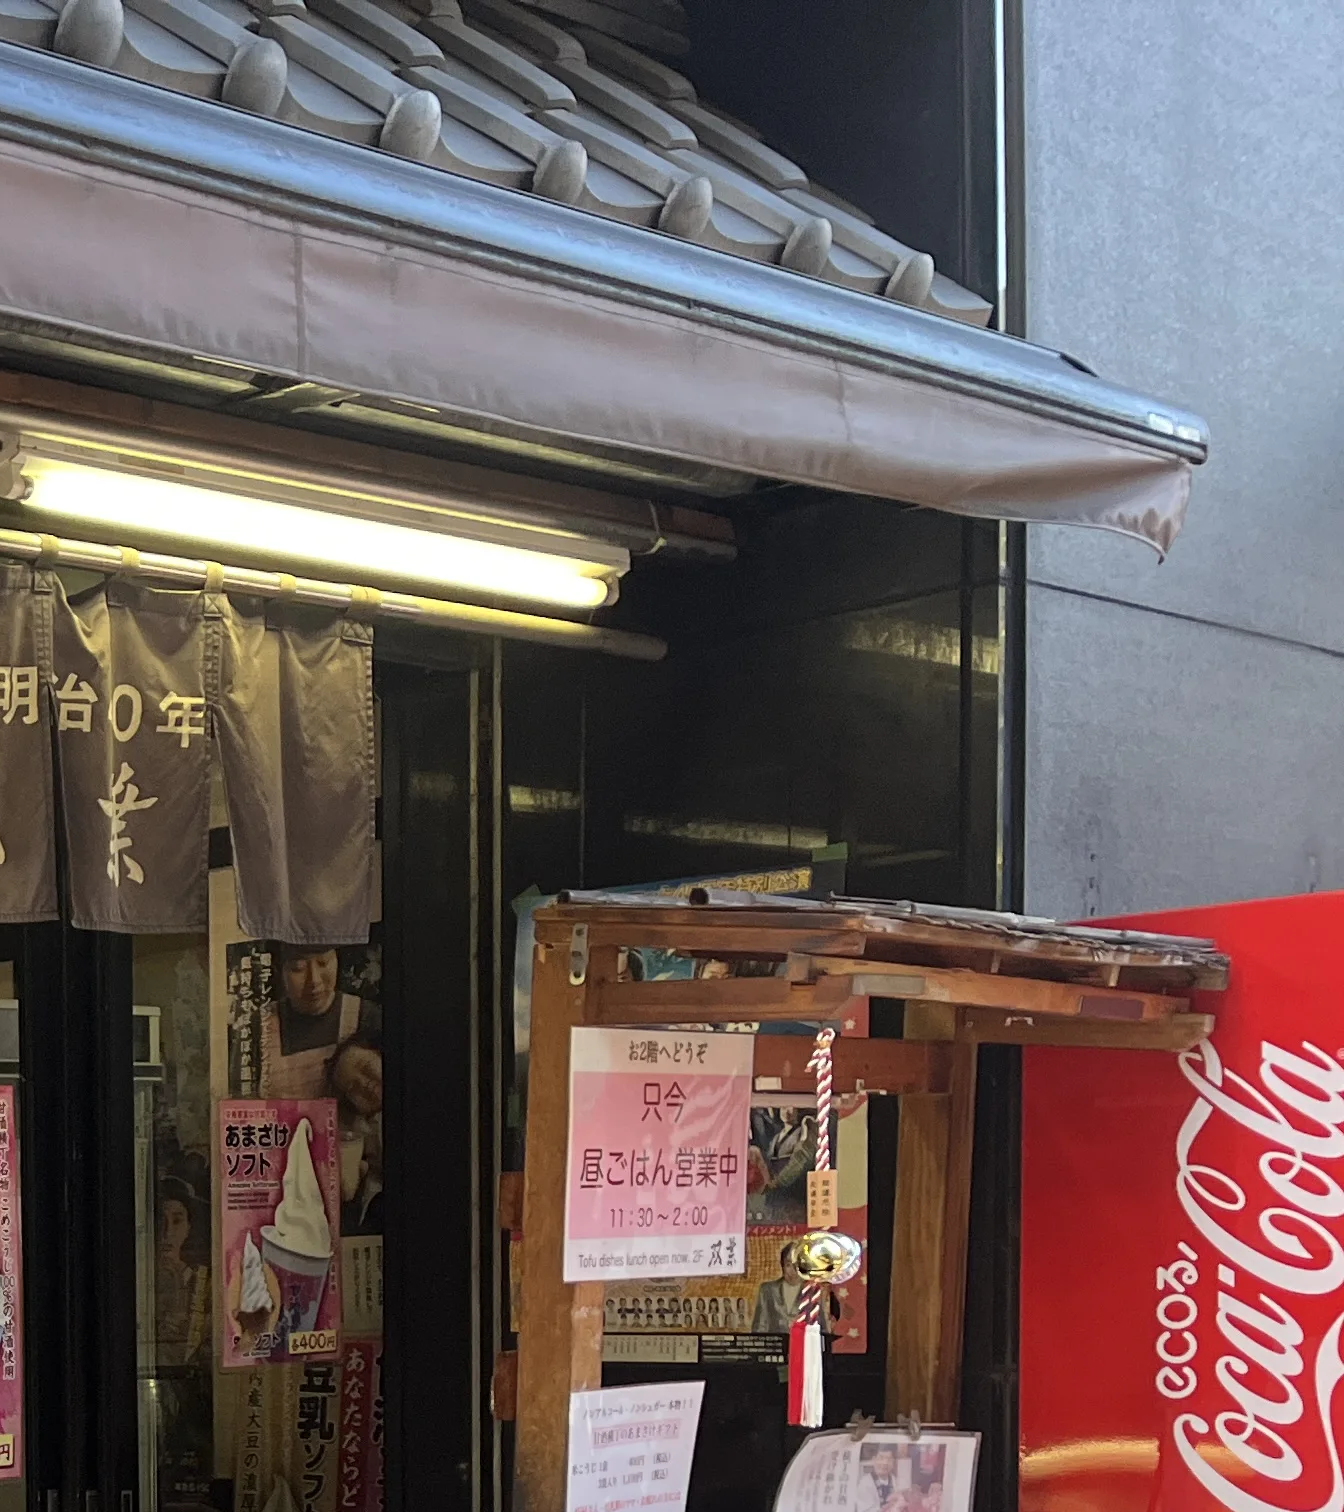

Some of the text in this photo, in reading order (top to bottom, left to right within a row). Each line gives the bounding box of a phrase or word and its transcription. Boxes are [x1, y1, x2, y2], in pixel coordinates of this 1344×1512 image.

[629, 1040, 708, 1064] お2階へどうぞ
[642, 1081, 687, 1123] 只今
[225, 1124, 289, 1149] あまざけ
[226, 1152, 271, 1177] ソフト
[579, 1147, 738, 1189] 昼ごはん営業中
